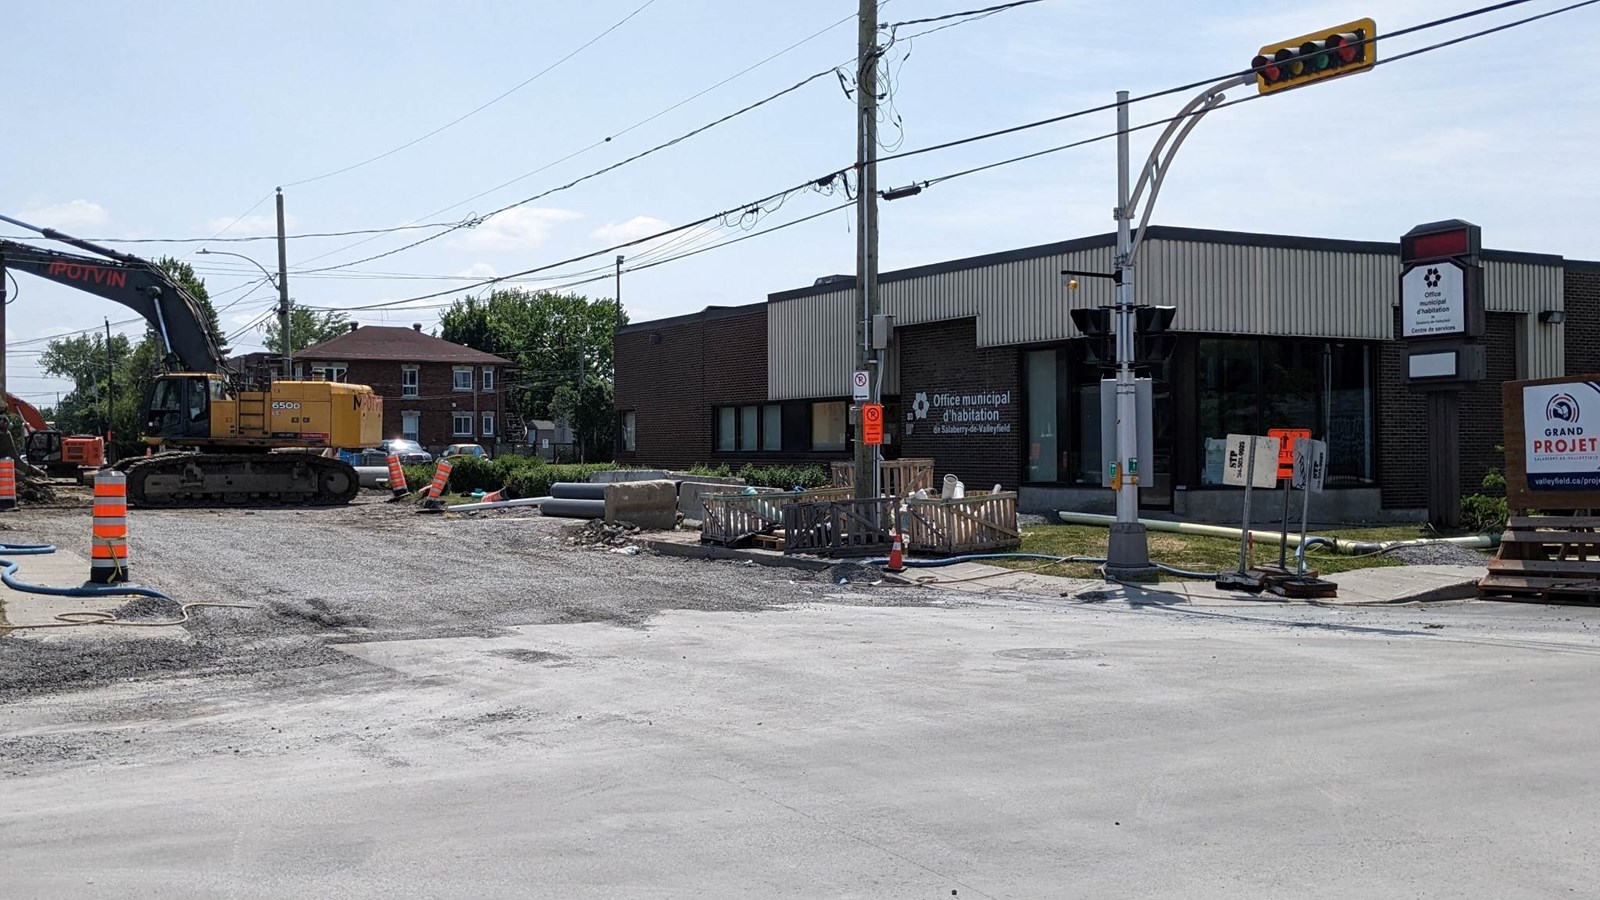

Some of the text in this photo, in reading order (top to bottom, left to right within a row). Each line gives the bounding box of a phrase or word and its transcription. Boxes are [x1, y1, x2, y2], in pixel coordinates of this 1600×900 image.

[1419, 298, 1447, 307] municipal
[1416, 306, 1450, 315] d'habitation
[933, 390, 1010, 407] Office municipal
[272, 402, 300, 410] 650D
[943, 408, 999, 422] d'habitation
[933, 424, 1010, 435] de Salaberry-de-Valleyfield
[1544, 426, 1584, 437] GRAND
[1533, 437, 1597, 454] PROJET
[1229, 450, 1238, 468] STP
